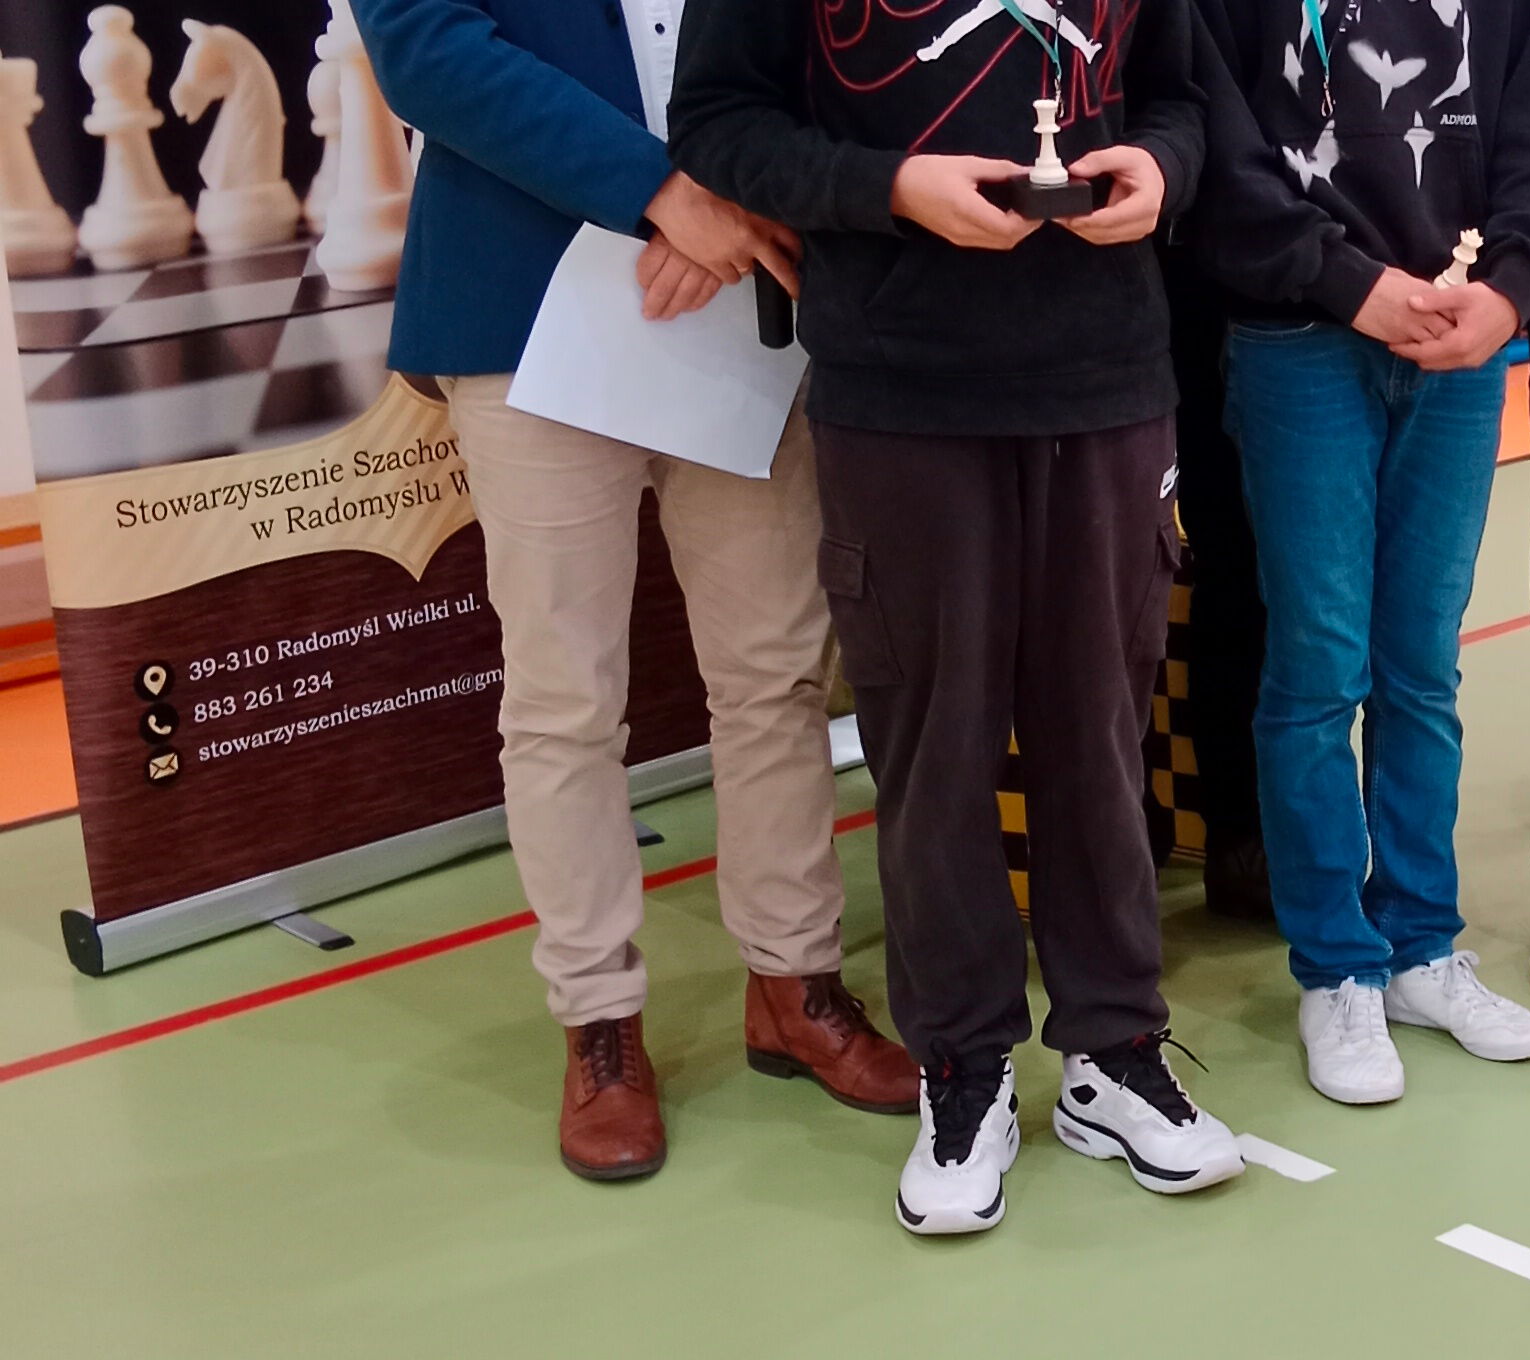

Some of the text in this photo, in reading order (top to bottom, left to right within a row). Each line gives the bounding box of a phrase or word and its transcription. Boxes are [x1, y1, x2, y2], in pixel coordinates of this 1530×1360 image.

[116, 457, 344, 529] Stowarzyszenie
[251, 518, 274, 541] w
[286, 478, 442, 535] Radomyślu
[189, 592, 482, 682] 39-310 Radomyśl Wielki ul.
[193, 670, 334, 724] 883 261 234
